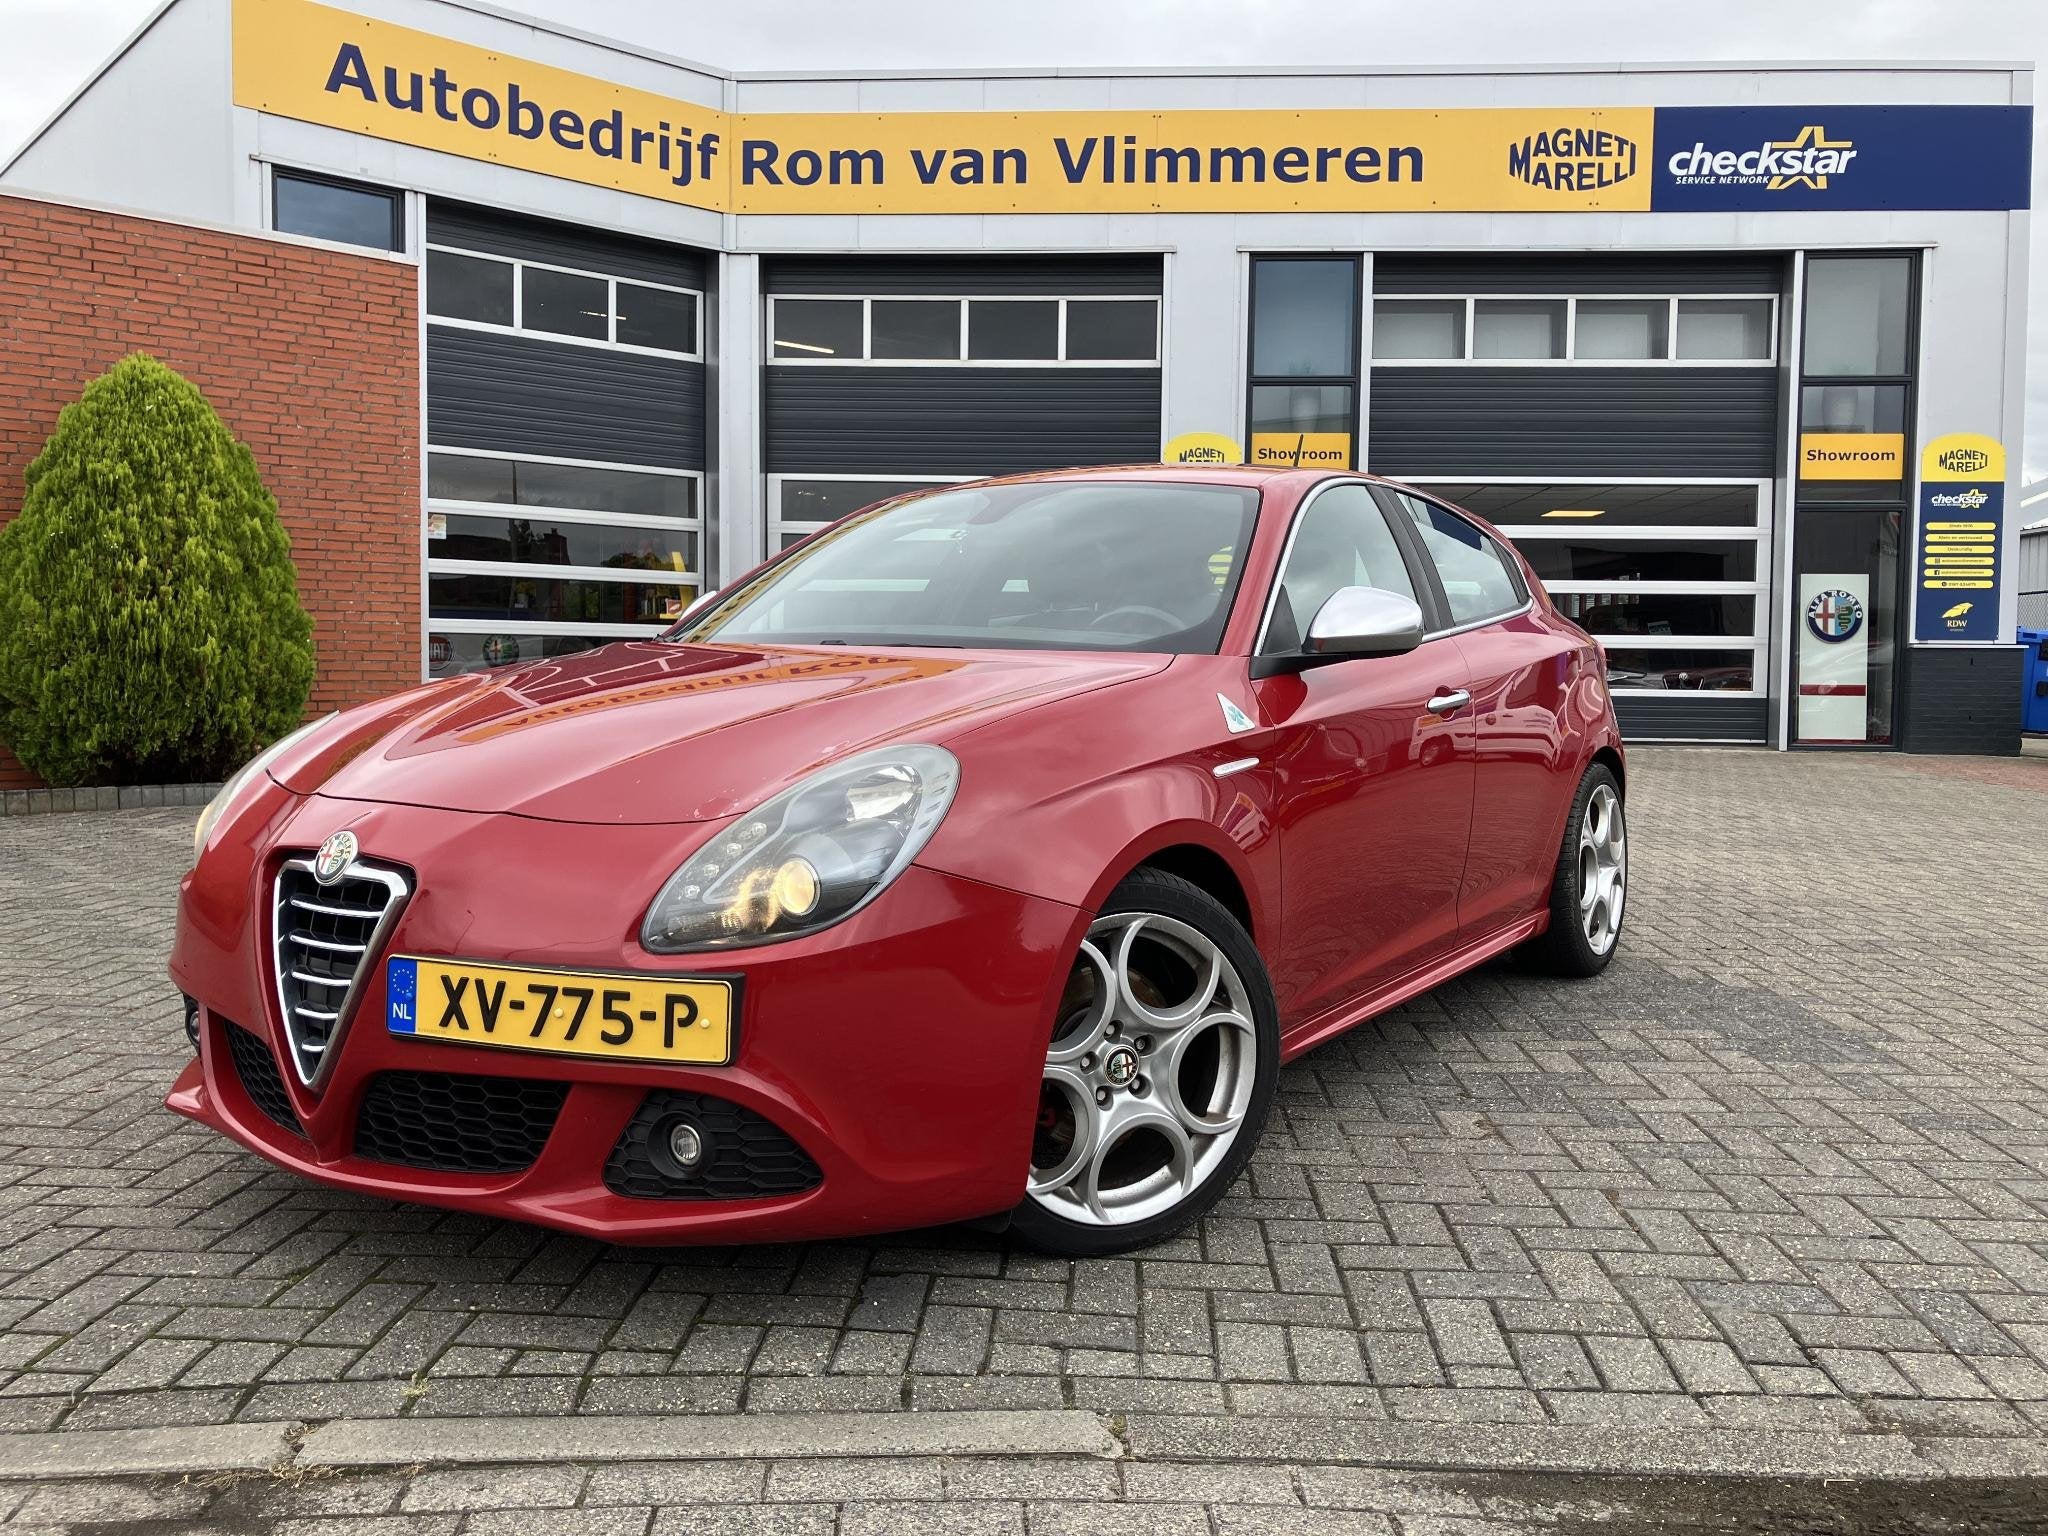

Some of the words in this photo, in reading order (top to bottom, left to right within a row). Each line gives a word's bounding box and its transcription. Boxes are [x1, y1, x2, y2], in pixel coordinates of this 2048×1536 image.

[324, 42, 720, 187] Autobedrijf
[741, 139, 884, 186] Rom
[909, 146, 1028, 186] van
[1053, 135, 1425, 184] Vlimmeren
[1509, 128, 1636, 163] MAGNETI
[1668, 142, 1858, 176] checkstar
[1509, 158, 1636, 192] MARELLI
[1675, 175, 1716, 185] SERVICE
[1718, 175, 1770, 185] NETWORK
[1179, 447, 1225, 461] MAGNETI
[1258, 448, 1342, 460] Showroom
[1806, 449, 1896, 462] Showroom
[1939, 449, 1988, 462] MAGNETI
[1939, 460, 1988, 473] MARELLI
[1931, 493, 1989, 504] checkstar
[1808, 592, 1828, 619] ALFA
[1831, 589, 1863, 619] ROMEO
[1947, 619, 1968, 628] RDW
[392, 1003, 412, 1021] NL
[439, 975, 699, 1048] XV-775-P
